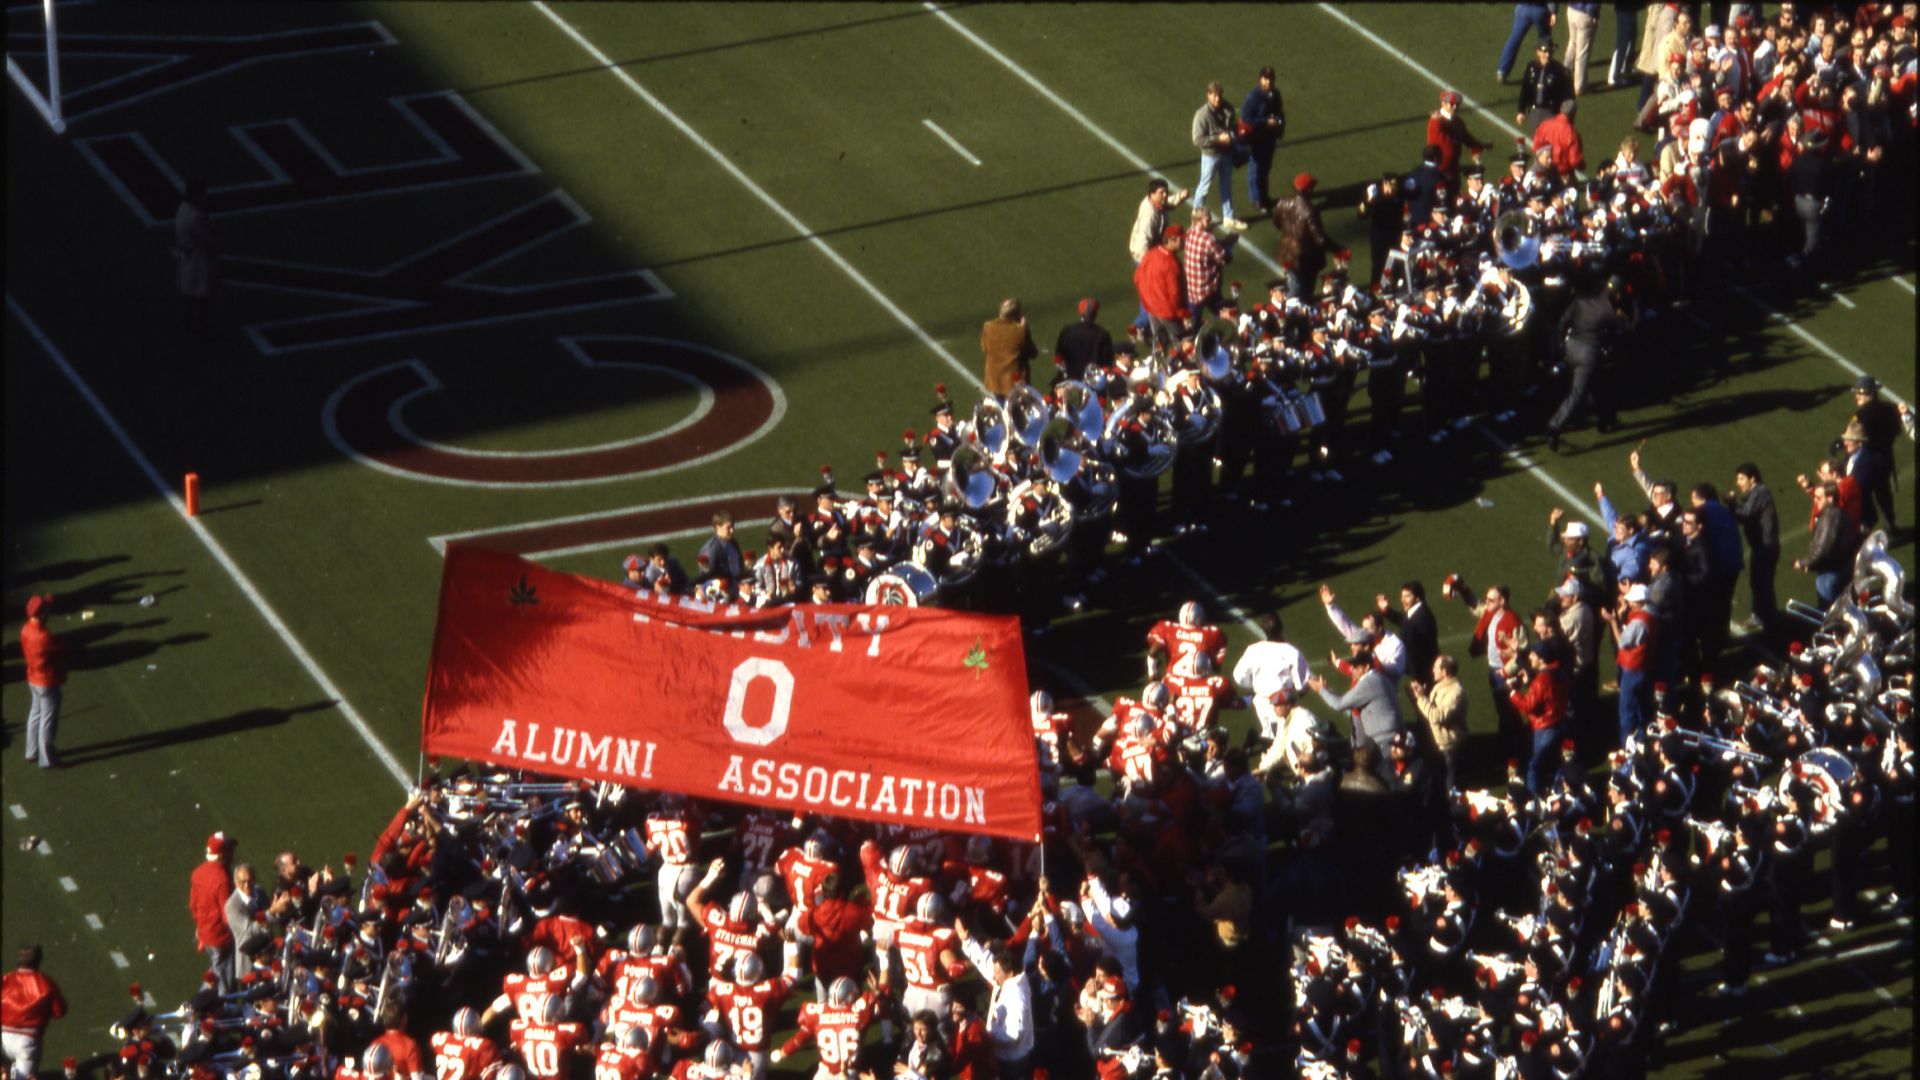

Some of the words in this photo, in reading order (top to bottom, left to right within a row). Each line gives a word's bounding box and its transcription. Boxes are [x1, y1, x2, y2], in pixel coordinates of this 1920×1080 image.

[492, 719, 657, 779] ALUMNI
[718, 755, 986, 823] ASSOCIATION
[901, 947, 934, 984] 51
[728, 1006, 763, 1044] 19
[522, 1040, 559, 1076] 10
[816, 1027, 860, 1064] 96
